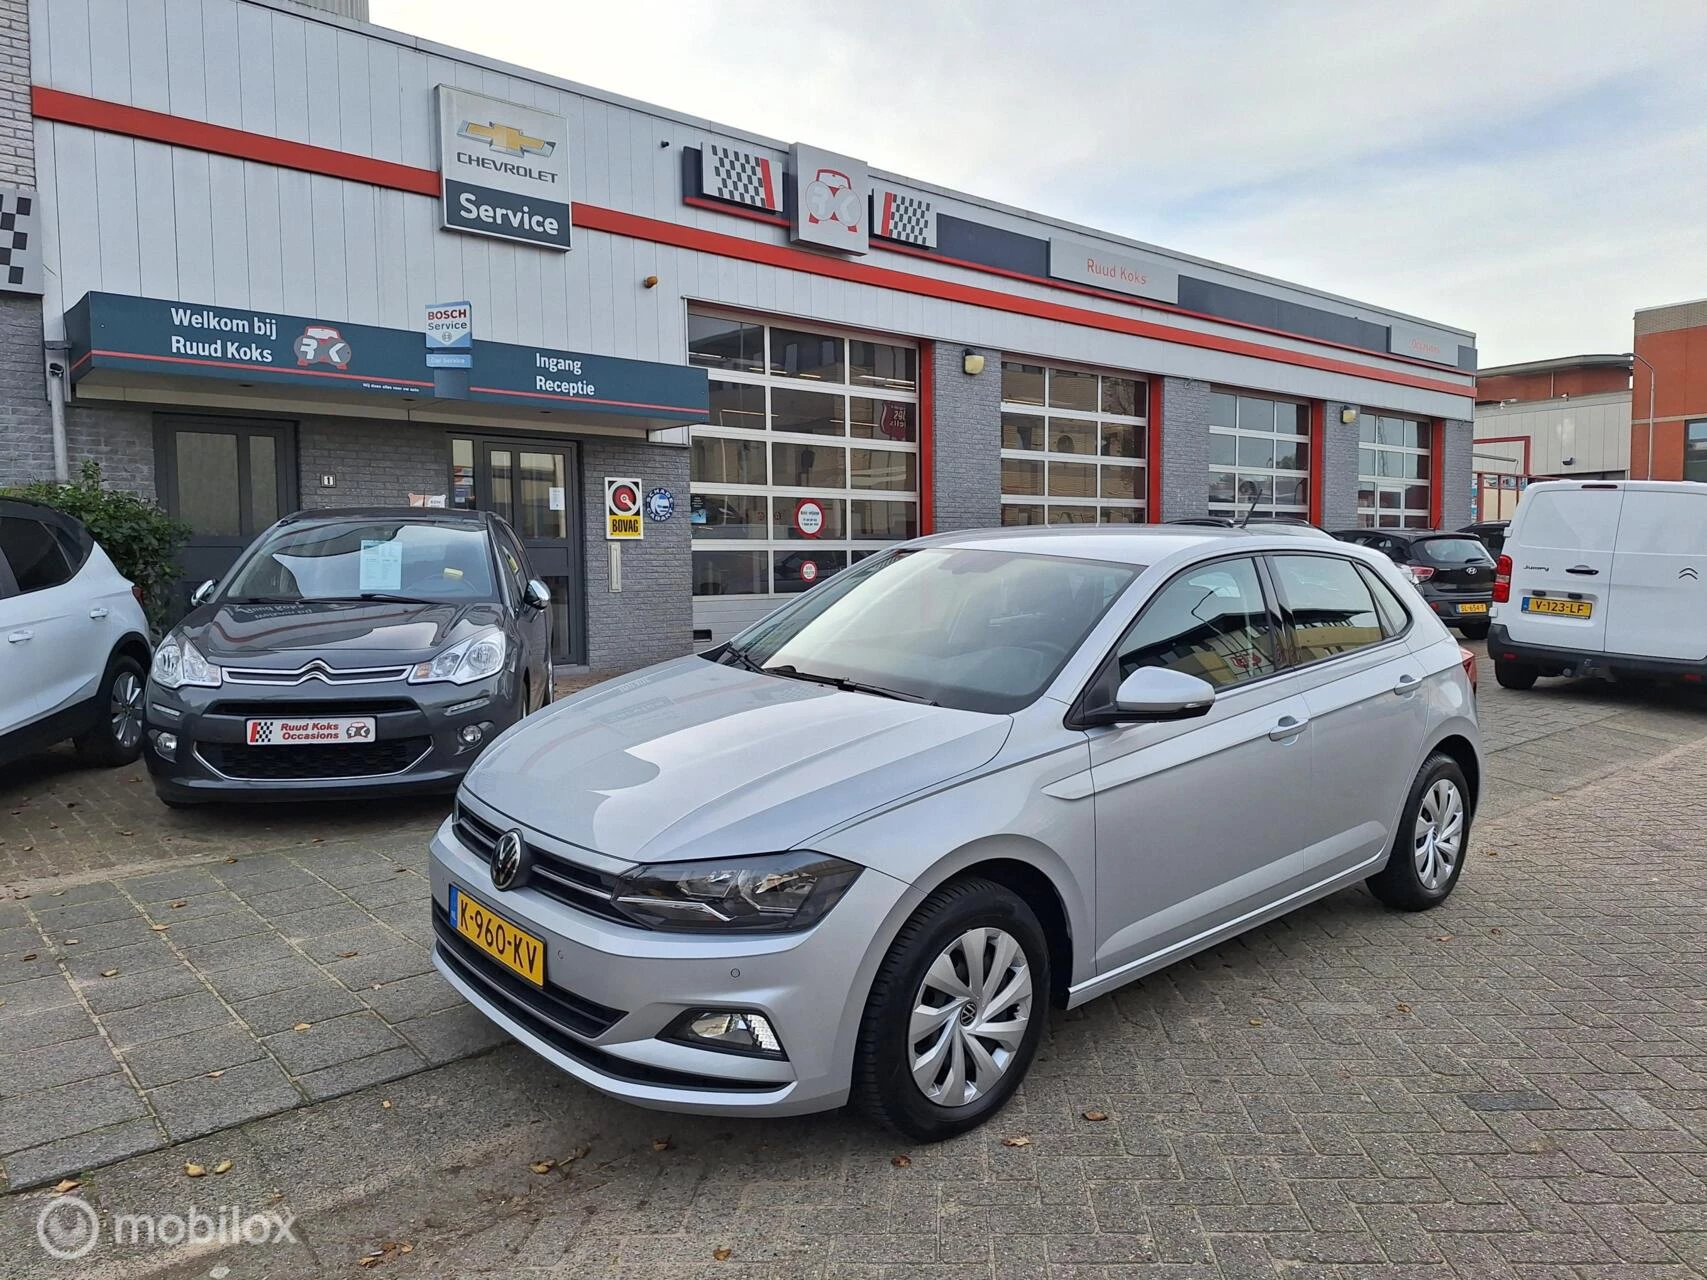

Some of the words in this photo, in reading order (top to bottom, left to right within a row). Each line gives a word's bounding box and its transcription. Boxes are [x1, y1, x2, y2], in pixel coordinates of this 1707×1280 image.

[456, 151, 559, 184] CHEVROLET
[459, 192, 559, 235] Service
[1087, 258, 1116, 278] Ruud
[1120, 266, 1147, 285] Koks
[170, 307, 249, 333] Welkom
[253, 316, 277, 340] bij
[428, 309, 467, 321] BOSCH
[428, 321, 468, 331] Service
[171, 335, 222, 358] Ruud
[226, 341, 273, 363] Koks
[535, 352, 583, 375] Ingang
[535, 375, 596, 397] Receptie
[612, 519, 639, 533] BOVAG
[1535, 600, 1585, 614] V-123-LF
[280, 723, 309, 732] Ruud
[312, 722, 339, 731] Koks
[281, 731, 339, 740] Occasions
[460, 898, 538, 975] K-960-KV
